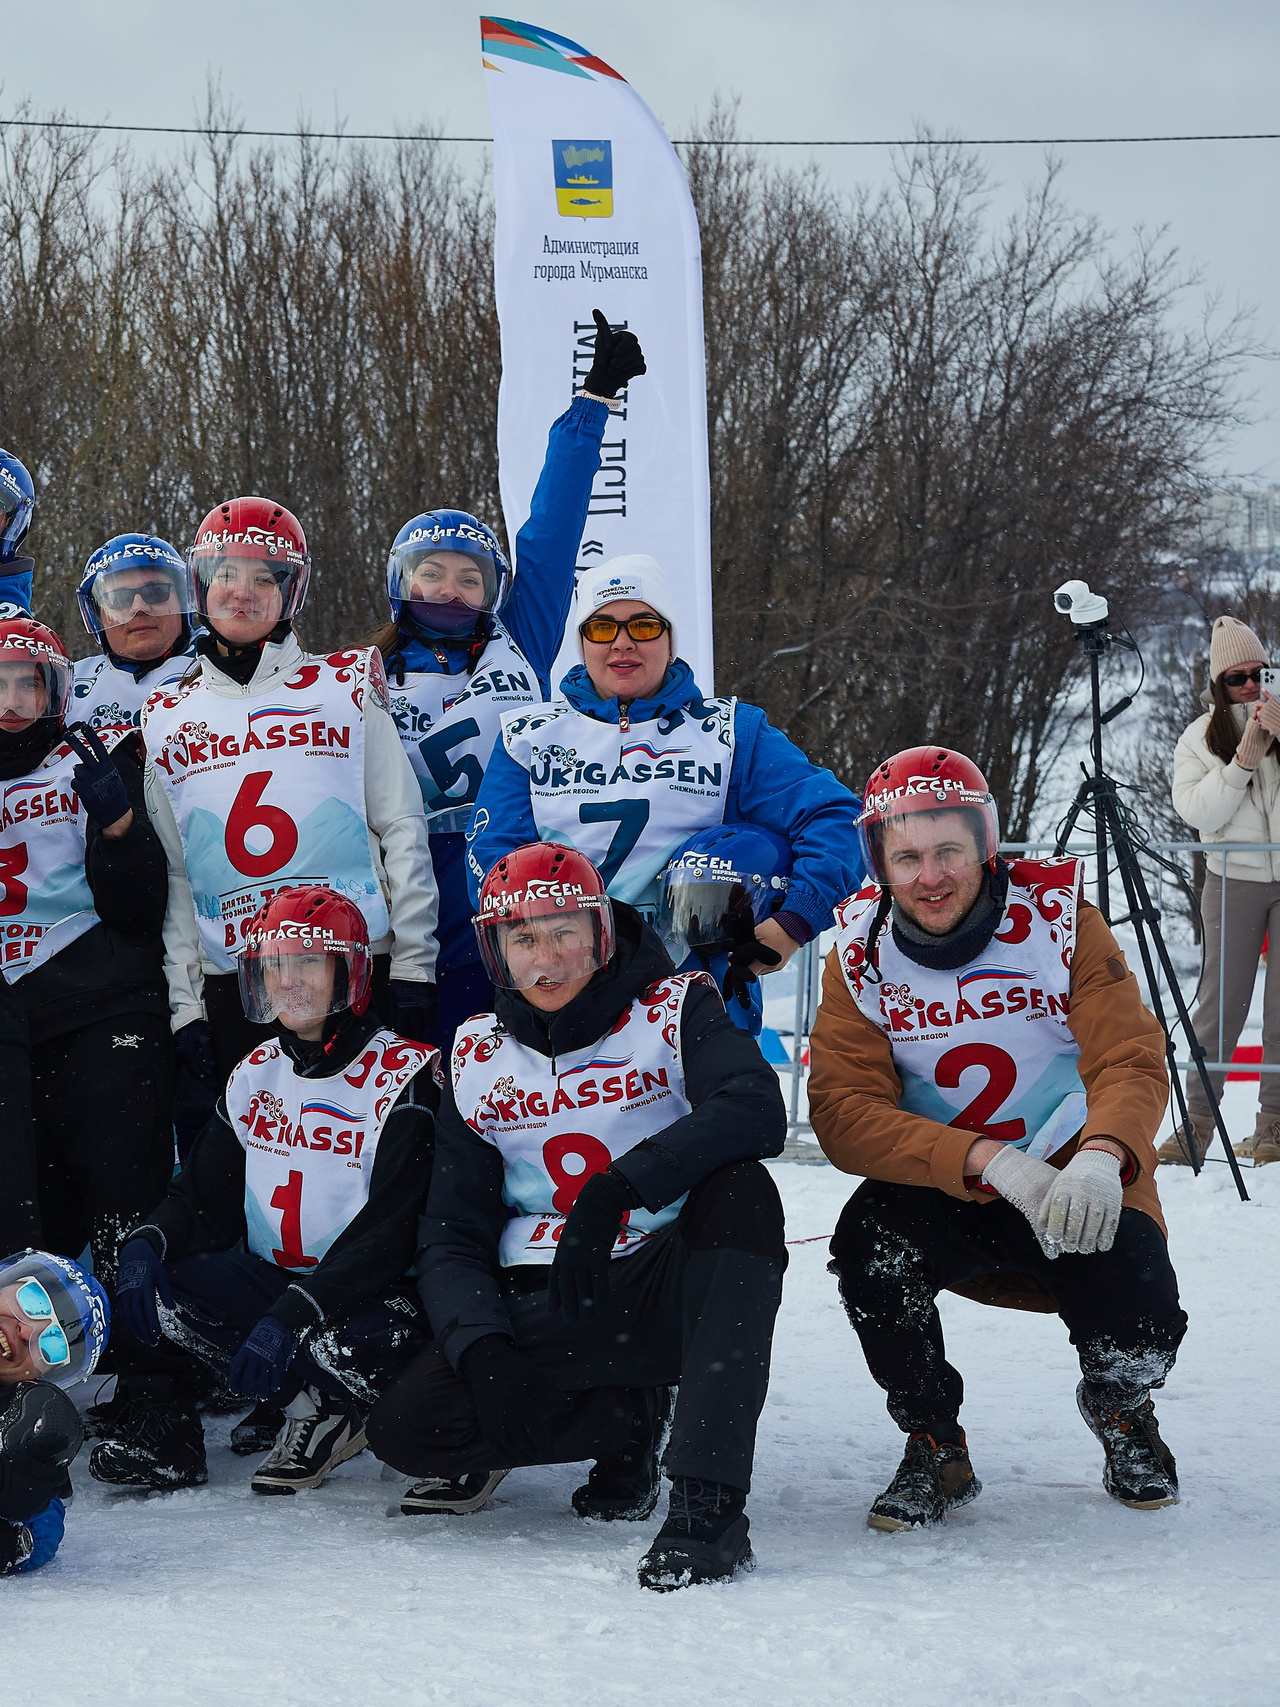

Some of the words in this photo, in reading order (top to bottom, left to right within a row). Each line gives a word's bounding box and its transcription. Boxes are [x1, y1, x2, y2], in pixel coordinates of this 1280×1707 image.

[542, 235, 639, 258] Администрация
[533, 263, 576, 281] города
[579, 259, 649, 281] Мурманска
[669, 784, 705, 796] СНЕЖНЫЙ
[706, 789, 721, 798] БОЙ
[224, 770, 299, 878] 6
[579, 798, 650, 893] 7
[221, 899, 236, 912] ДЛЯ
[235, 893, 256, 905] ТЕХ,
[233, 903, 257, 917] ЗНАЕТ
[224, 922, 237, 948] В
[935, 1042, 1026, 1141] 2
[620, 1094, 657, 1113] СНЕЖНЫЙ
[270, 1169, 320, 1269] 1
